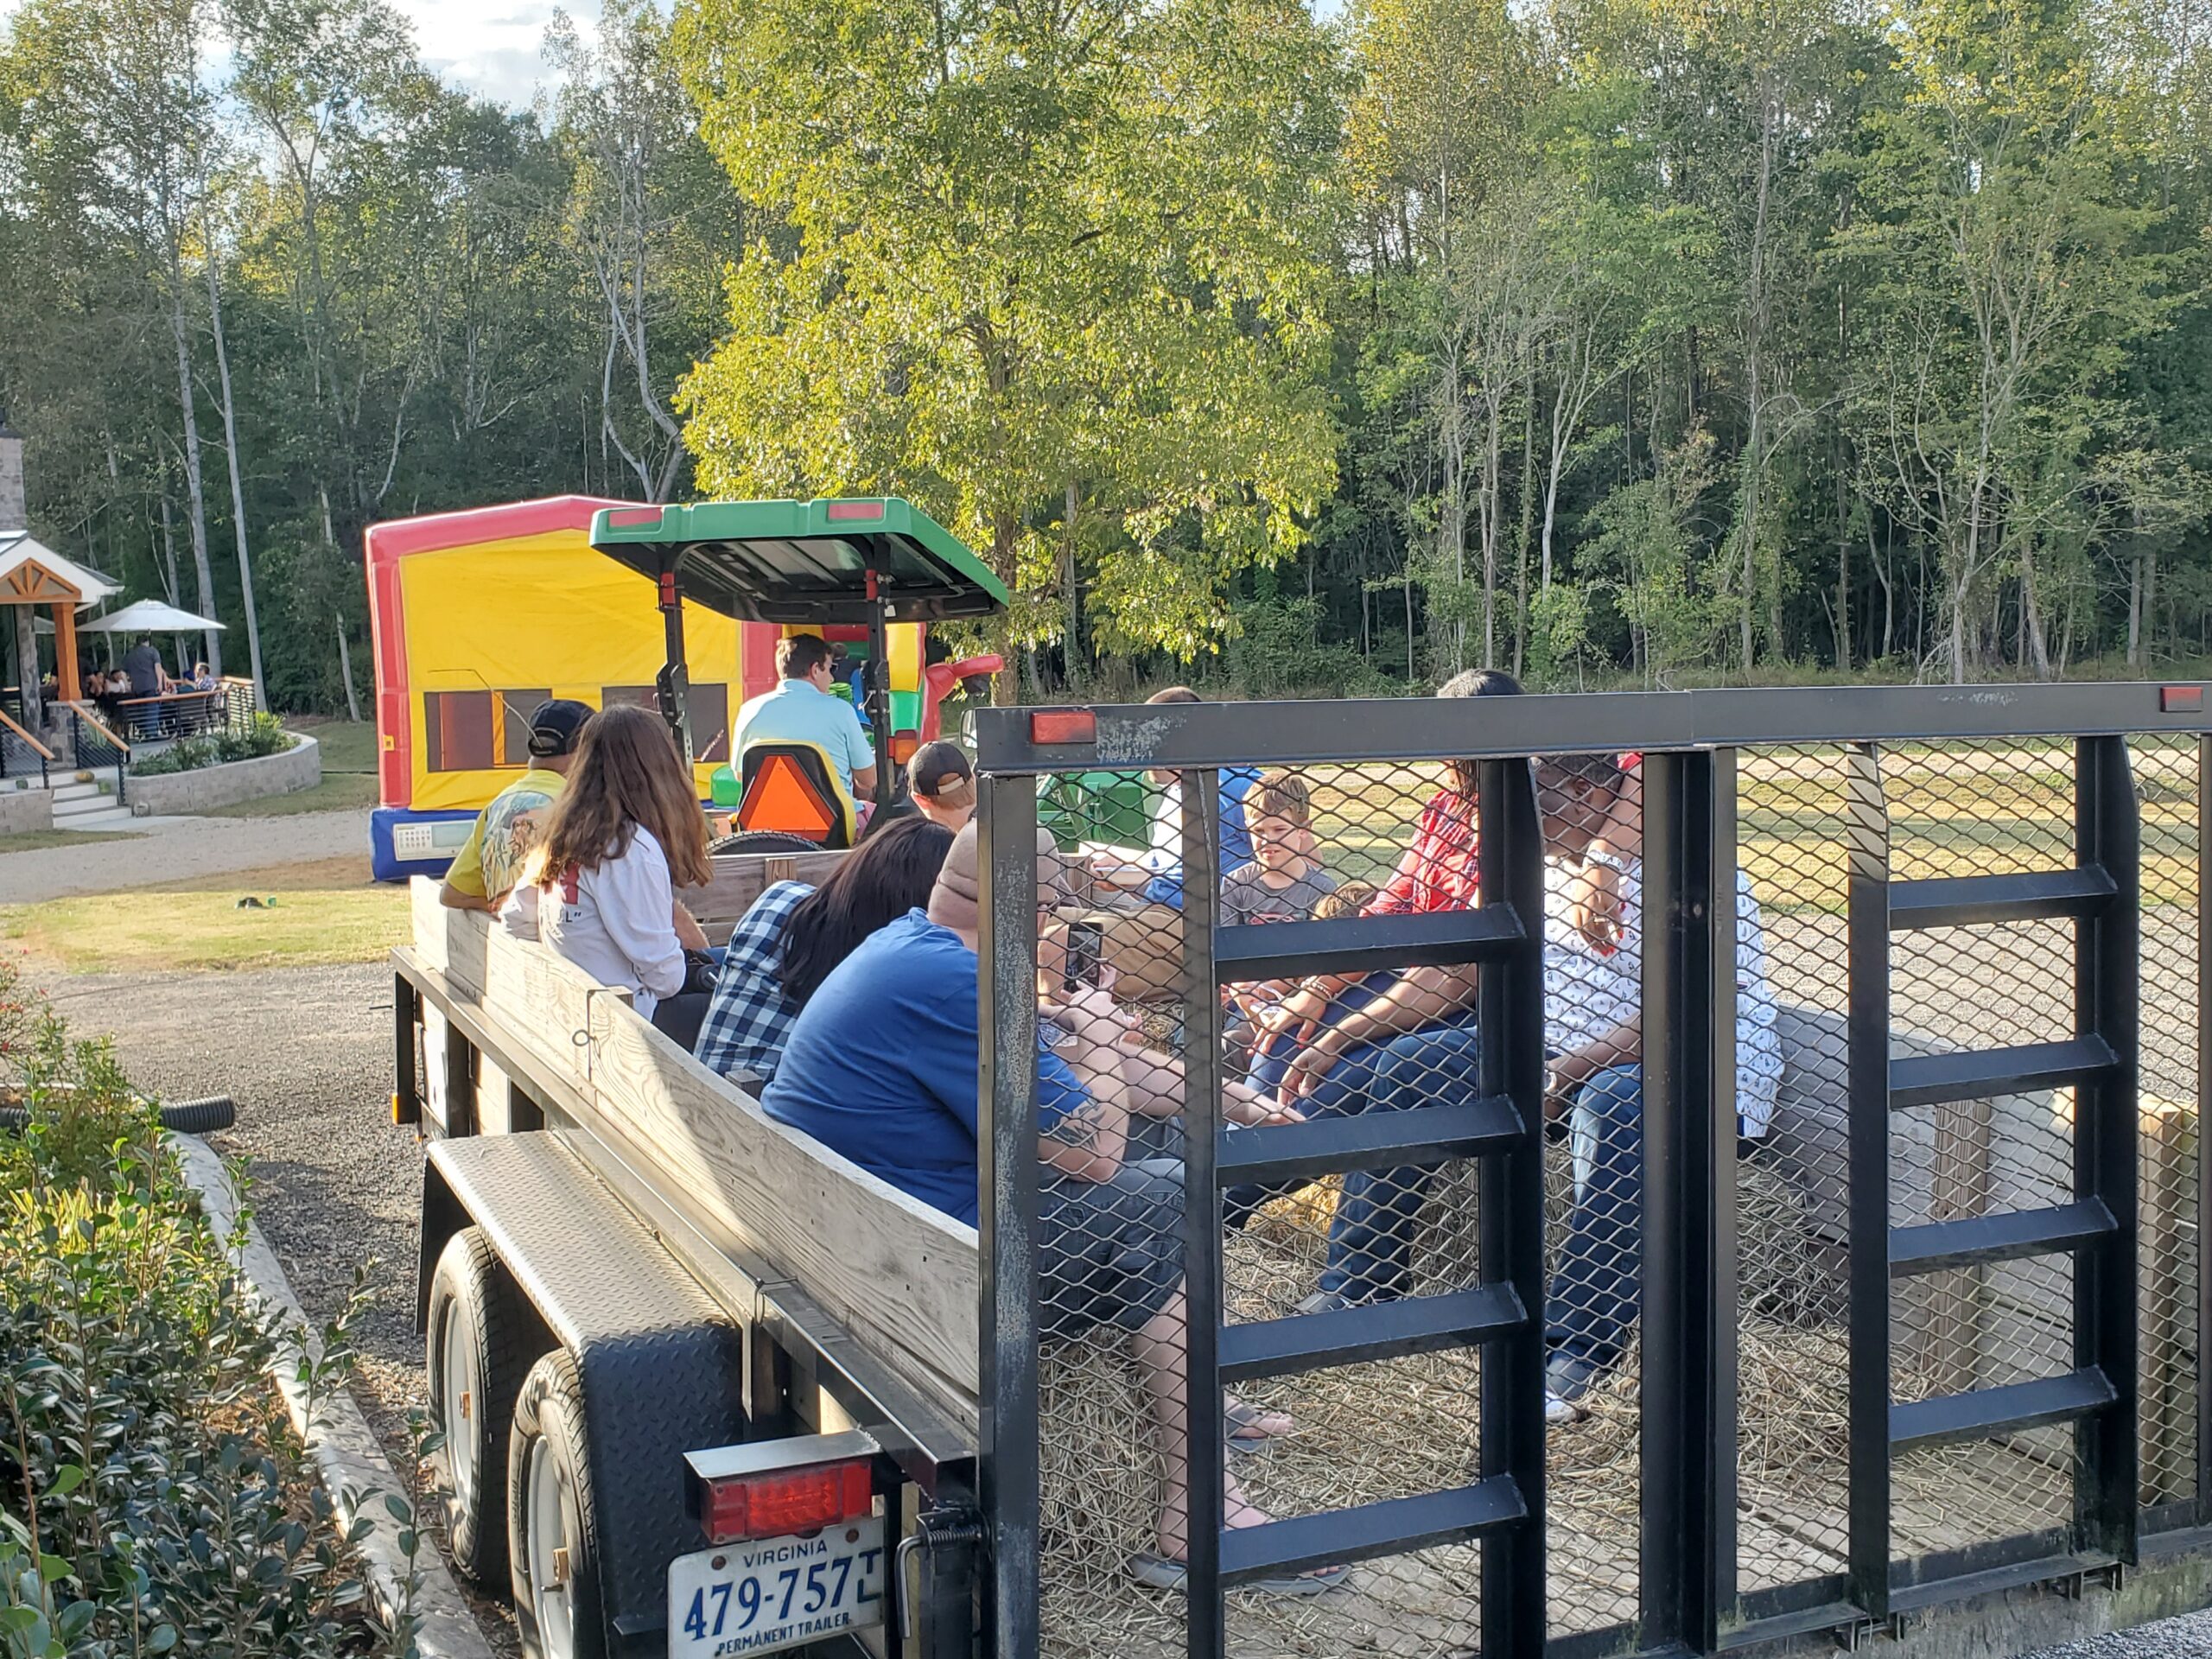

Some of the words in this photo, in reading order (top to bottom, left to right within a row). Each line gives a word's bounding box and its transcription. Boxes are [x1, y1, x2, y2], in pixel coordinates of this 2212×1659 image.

[743, 1540, 828, 1567] VIRGINIA
[683, 1556, 854, 1642] 479-757
[717, 1627, 794, 1655] PERMANENT
[798, 1612, 850, 1635] TRAILER
